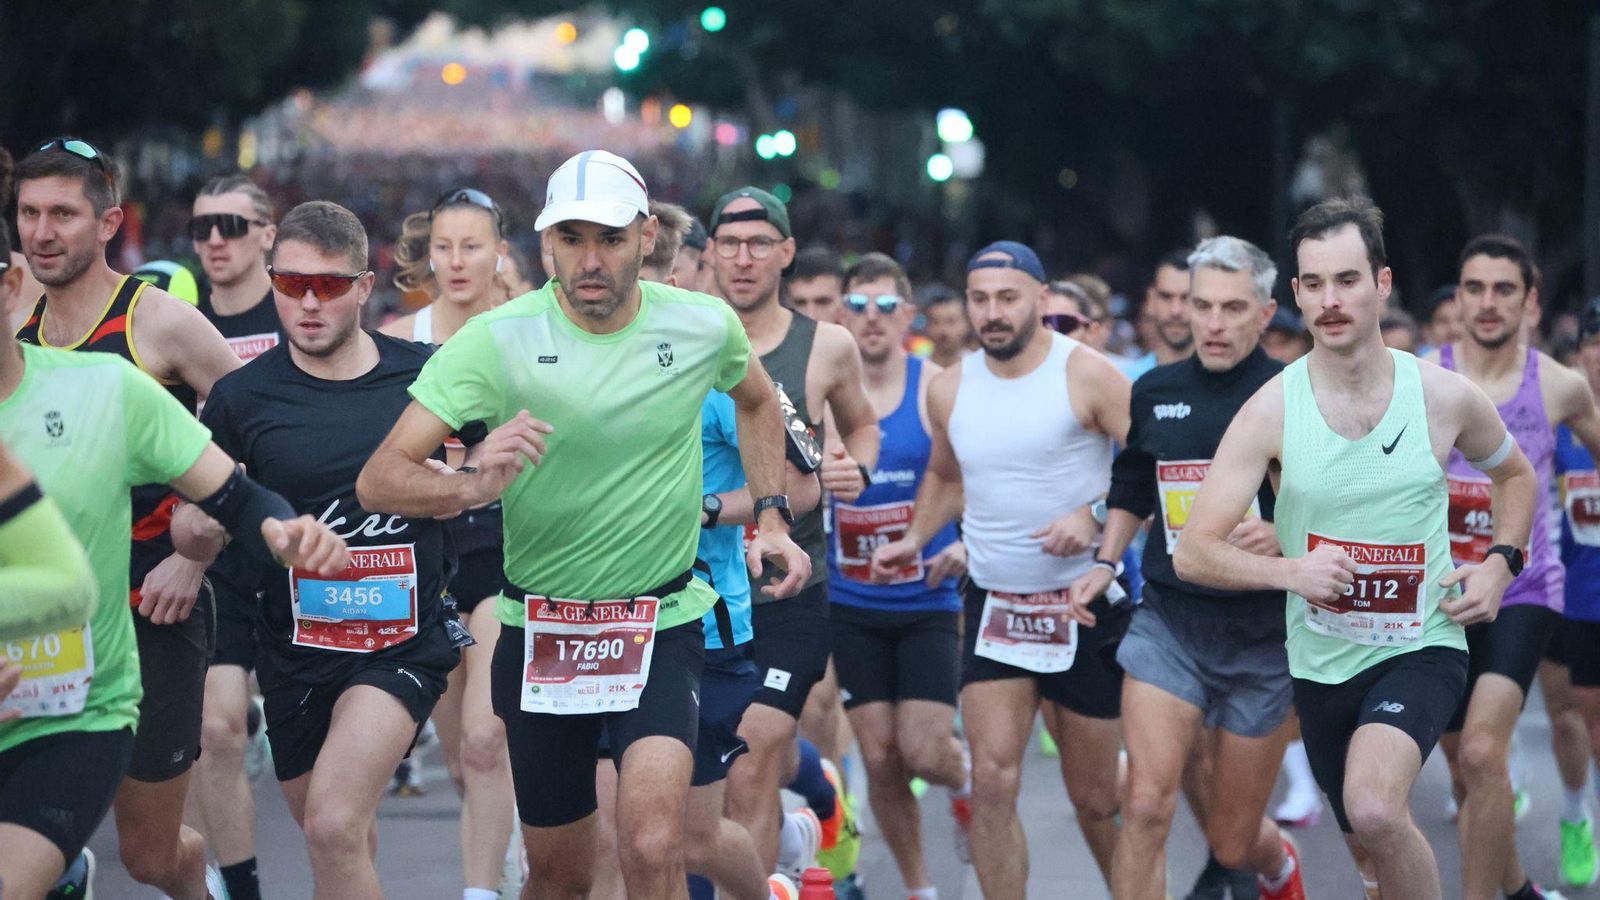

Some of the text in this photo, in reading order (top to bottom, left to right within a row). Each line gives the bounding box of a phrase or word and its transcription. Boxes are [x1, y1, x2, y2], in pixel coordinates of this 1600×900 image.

[1464, 510, 1493, 528] 49
[344, 551, 406, 569] NERALI
[324, 586, 384, 606] 3456
[1353, 599, 1371, 607] TOM
[563, 604, 649, 622] GENERALI
[555, 638, 625, 661] 17690
[576, 662, 600, 671] FABIO
